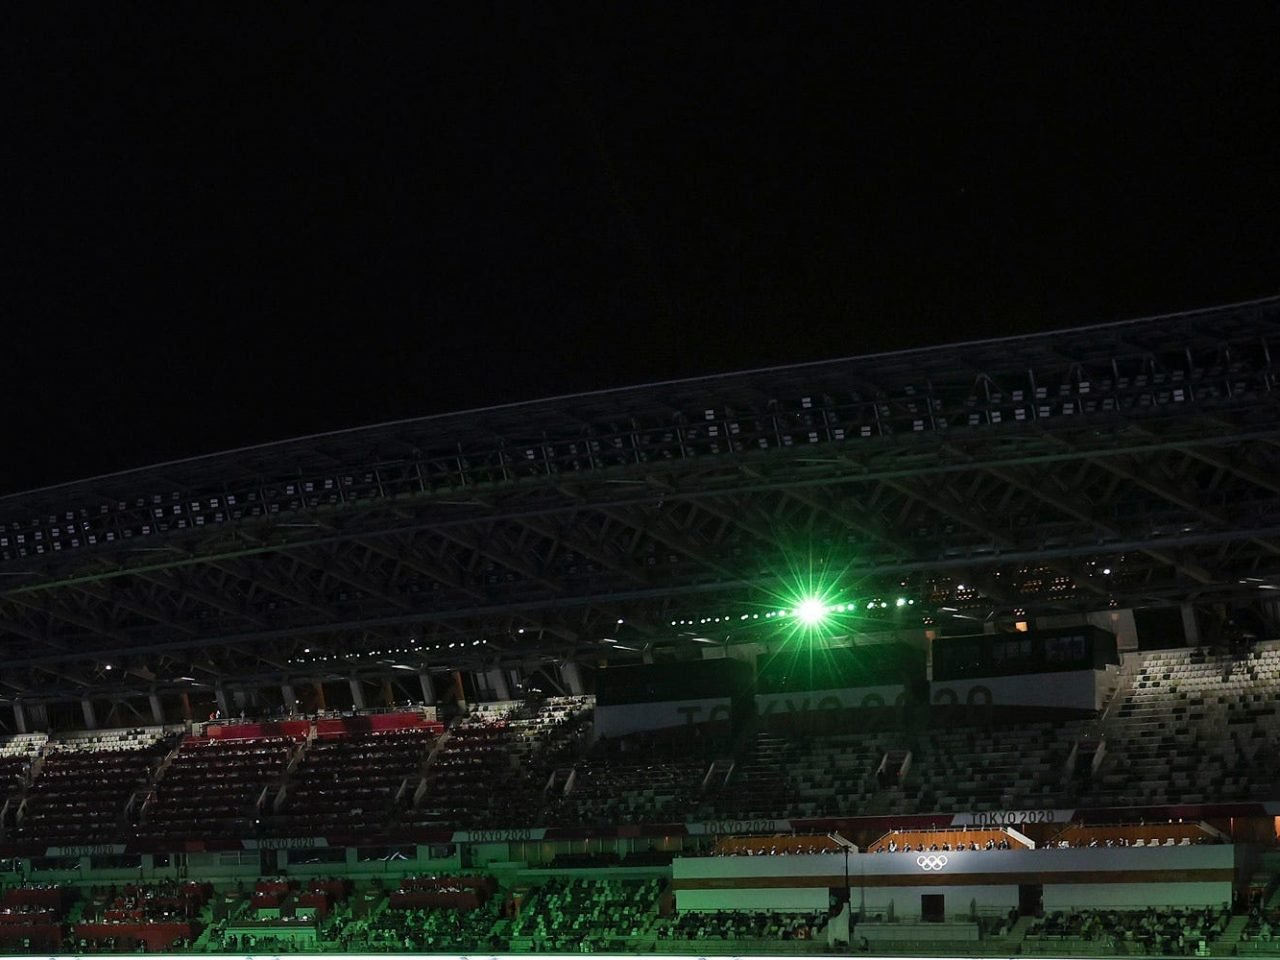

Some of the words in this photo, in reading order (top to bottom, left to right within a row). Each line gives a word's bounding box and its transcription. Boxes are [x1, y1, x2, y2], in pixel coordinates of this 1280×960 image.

[972, 811, 1016, 825] TOKYO
[1019, 810, 1054, 824] 2020
[704, 821, 741, 833] TOKYO
[746, 820, 775, 833] 2020
[468, 830, 501, 841] TOKYO
[505, 830, 531, 841] 2020
[257, 839, 288, 849] TOKYO
[291, 838, 315, 848] 2020
